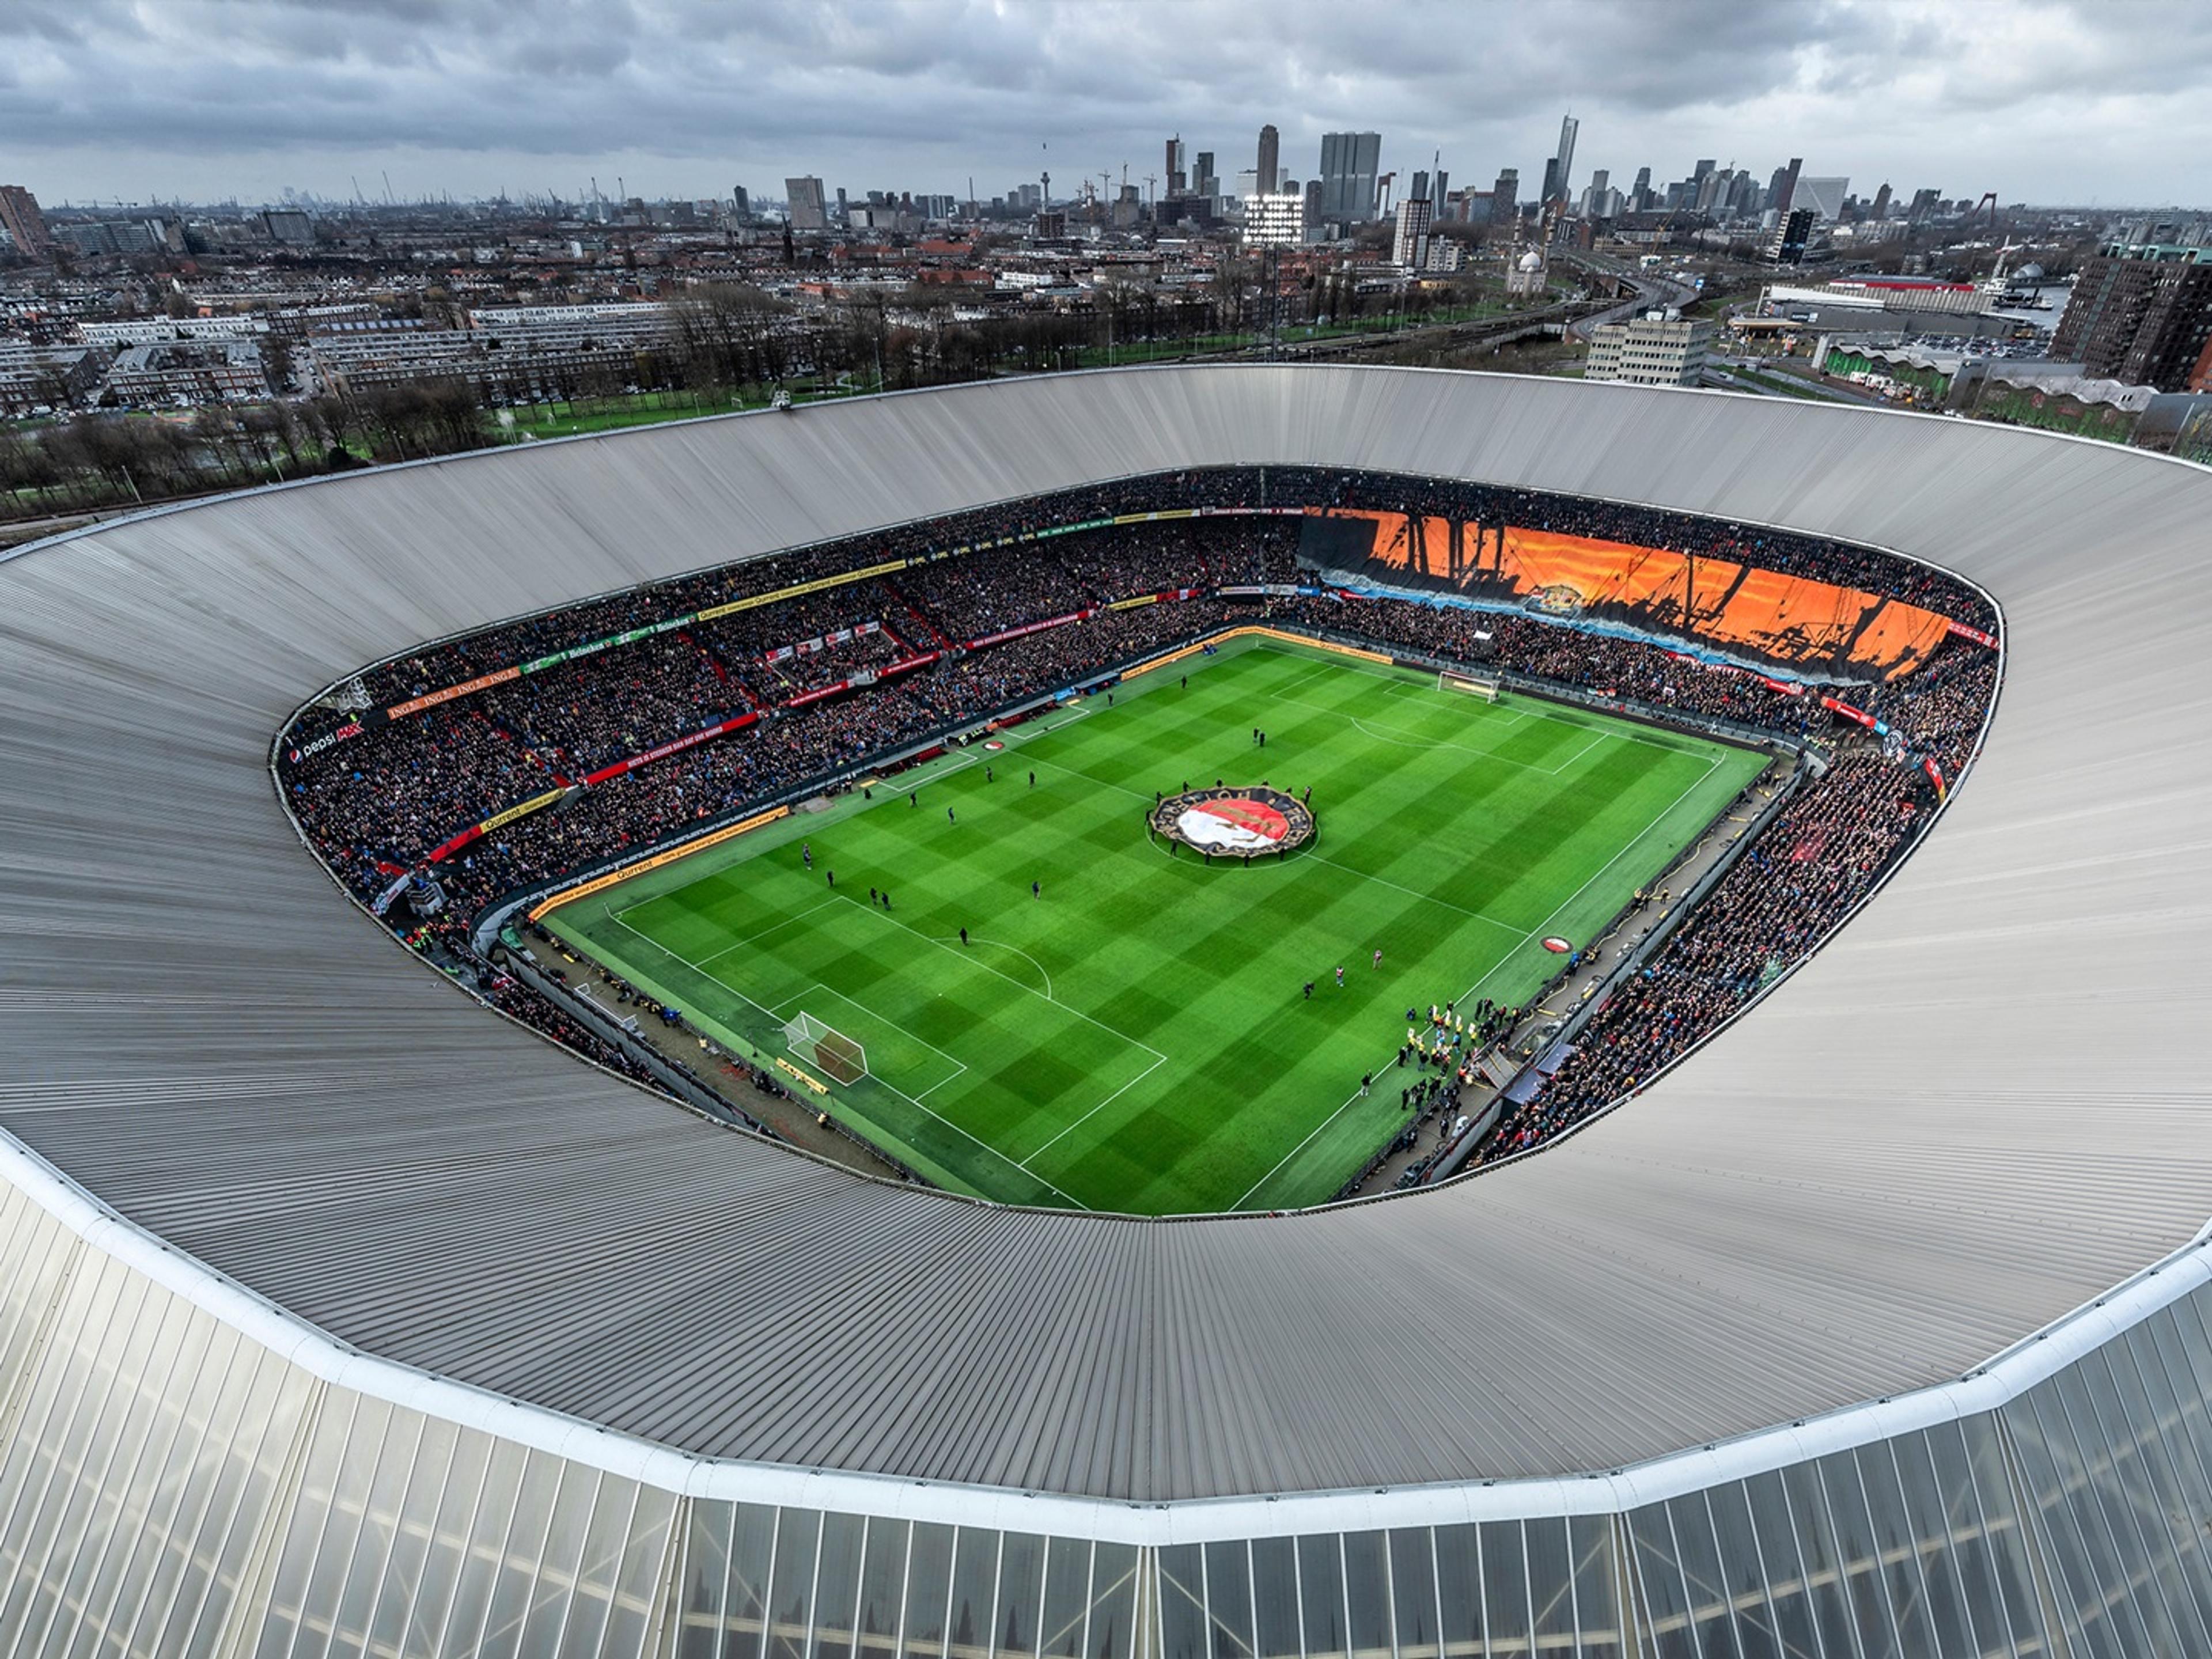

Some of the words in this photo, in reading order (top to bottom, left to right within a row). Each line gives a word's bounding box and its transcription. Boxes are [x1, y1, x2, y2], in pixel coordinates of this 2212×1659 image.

[568, 643, 604, 658] Heineken
[490, 673, 507, 684] ING
[457, 684, 475, 695] ING
[425, 695, 442, 706] ING
[391, 706, 408, 718] ING
[303, 732, 336, 757] pepsi
[336, 721, 365, 742] MAX
[617, 861, 653, 879] Qurrent
